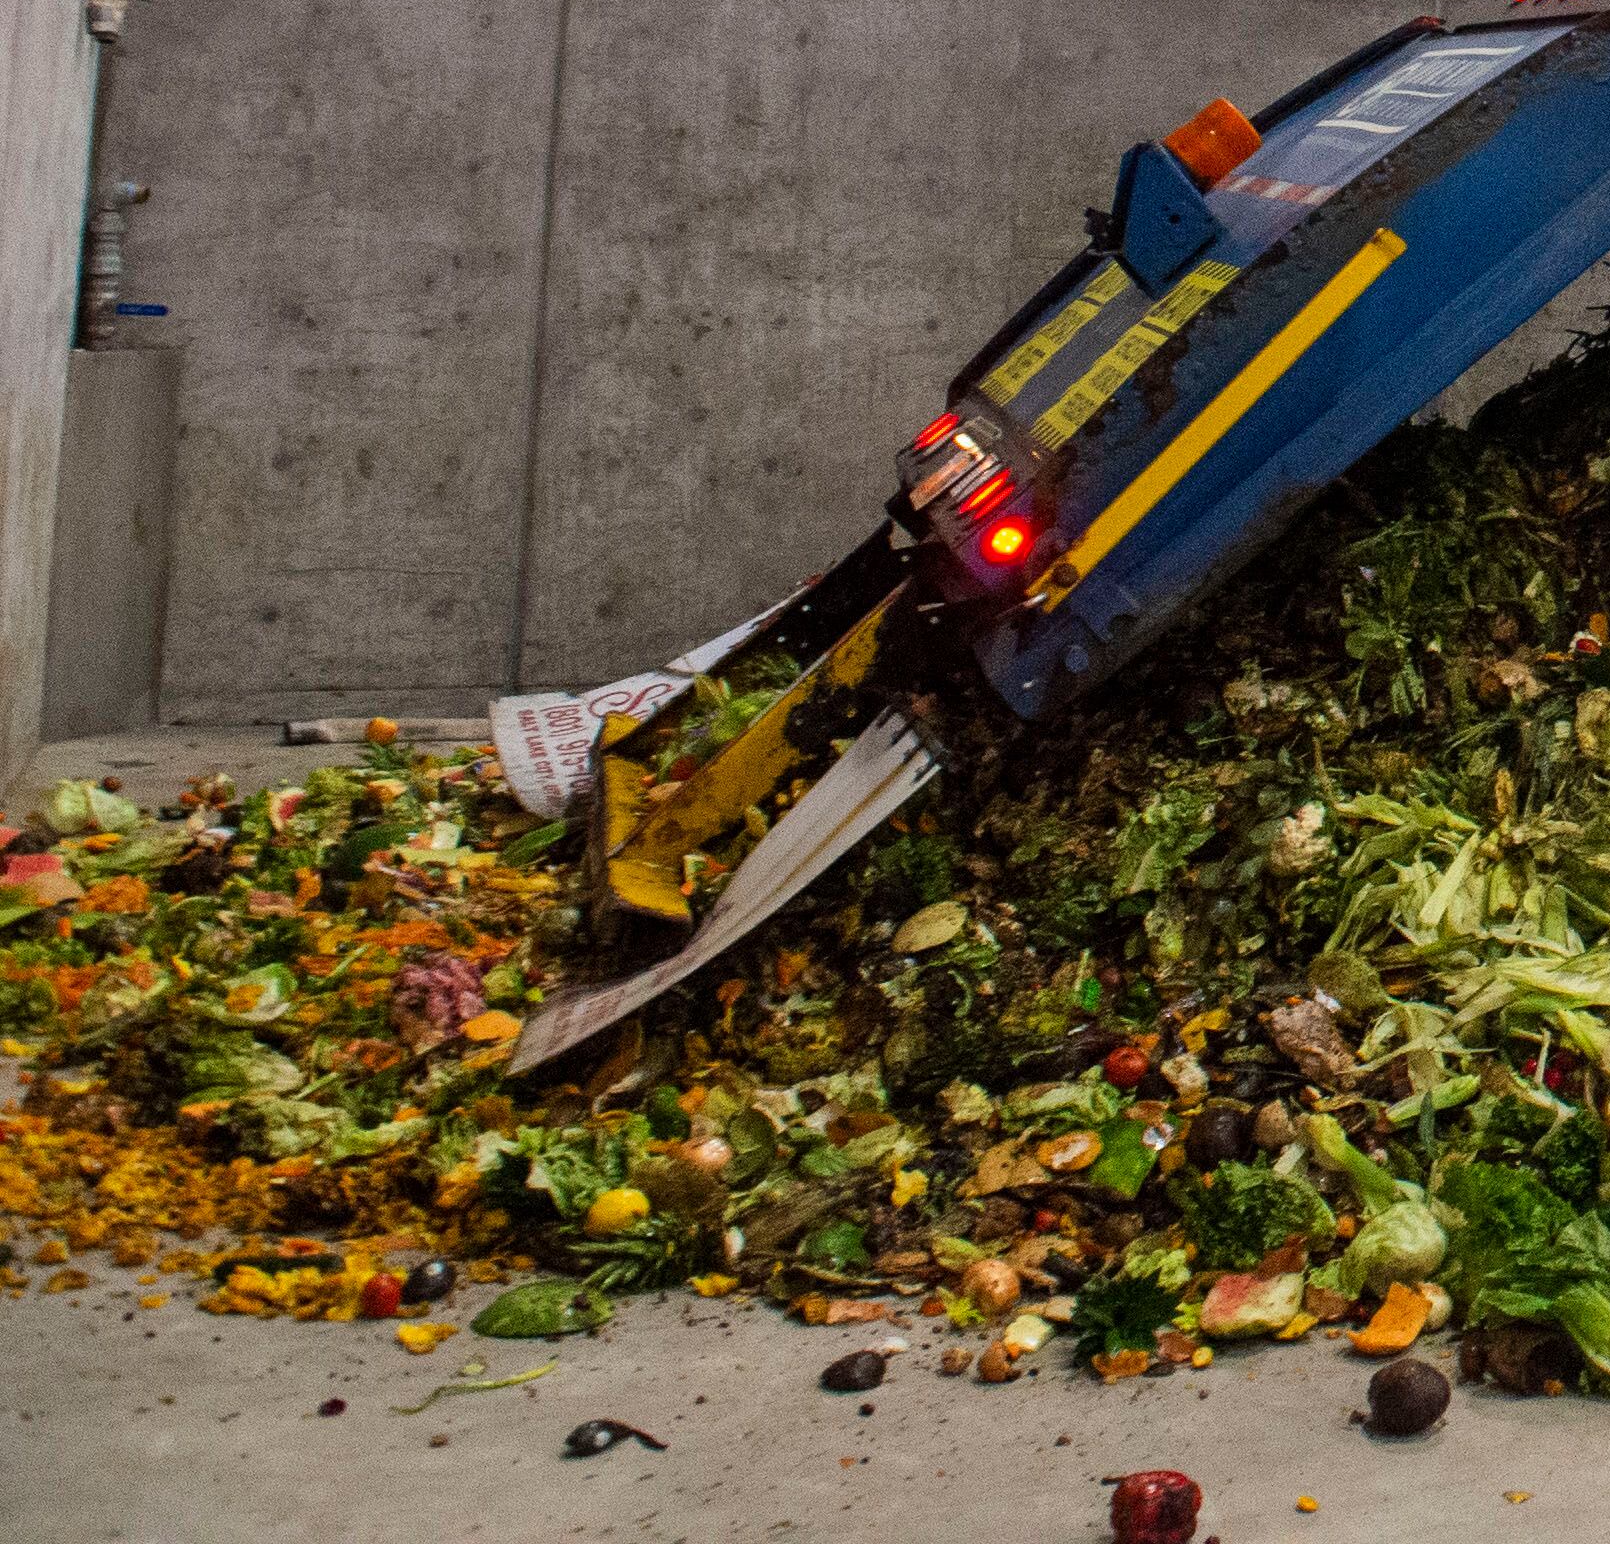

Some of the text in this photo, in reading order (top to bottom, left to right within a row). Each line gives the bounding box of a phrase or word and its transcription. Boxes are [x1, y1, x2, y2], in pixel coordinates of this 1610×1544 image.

[517, 708, 540, 732] SALT
[540, 704, 588, 738] (801)
[525, 735, 548, 759] LAKE
